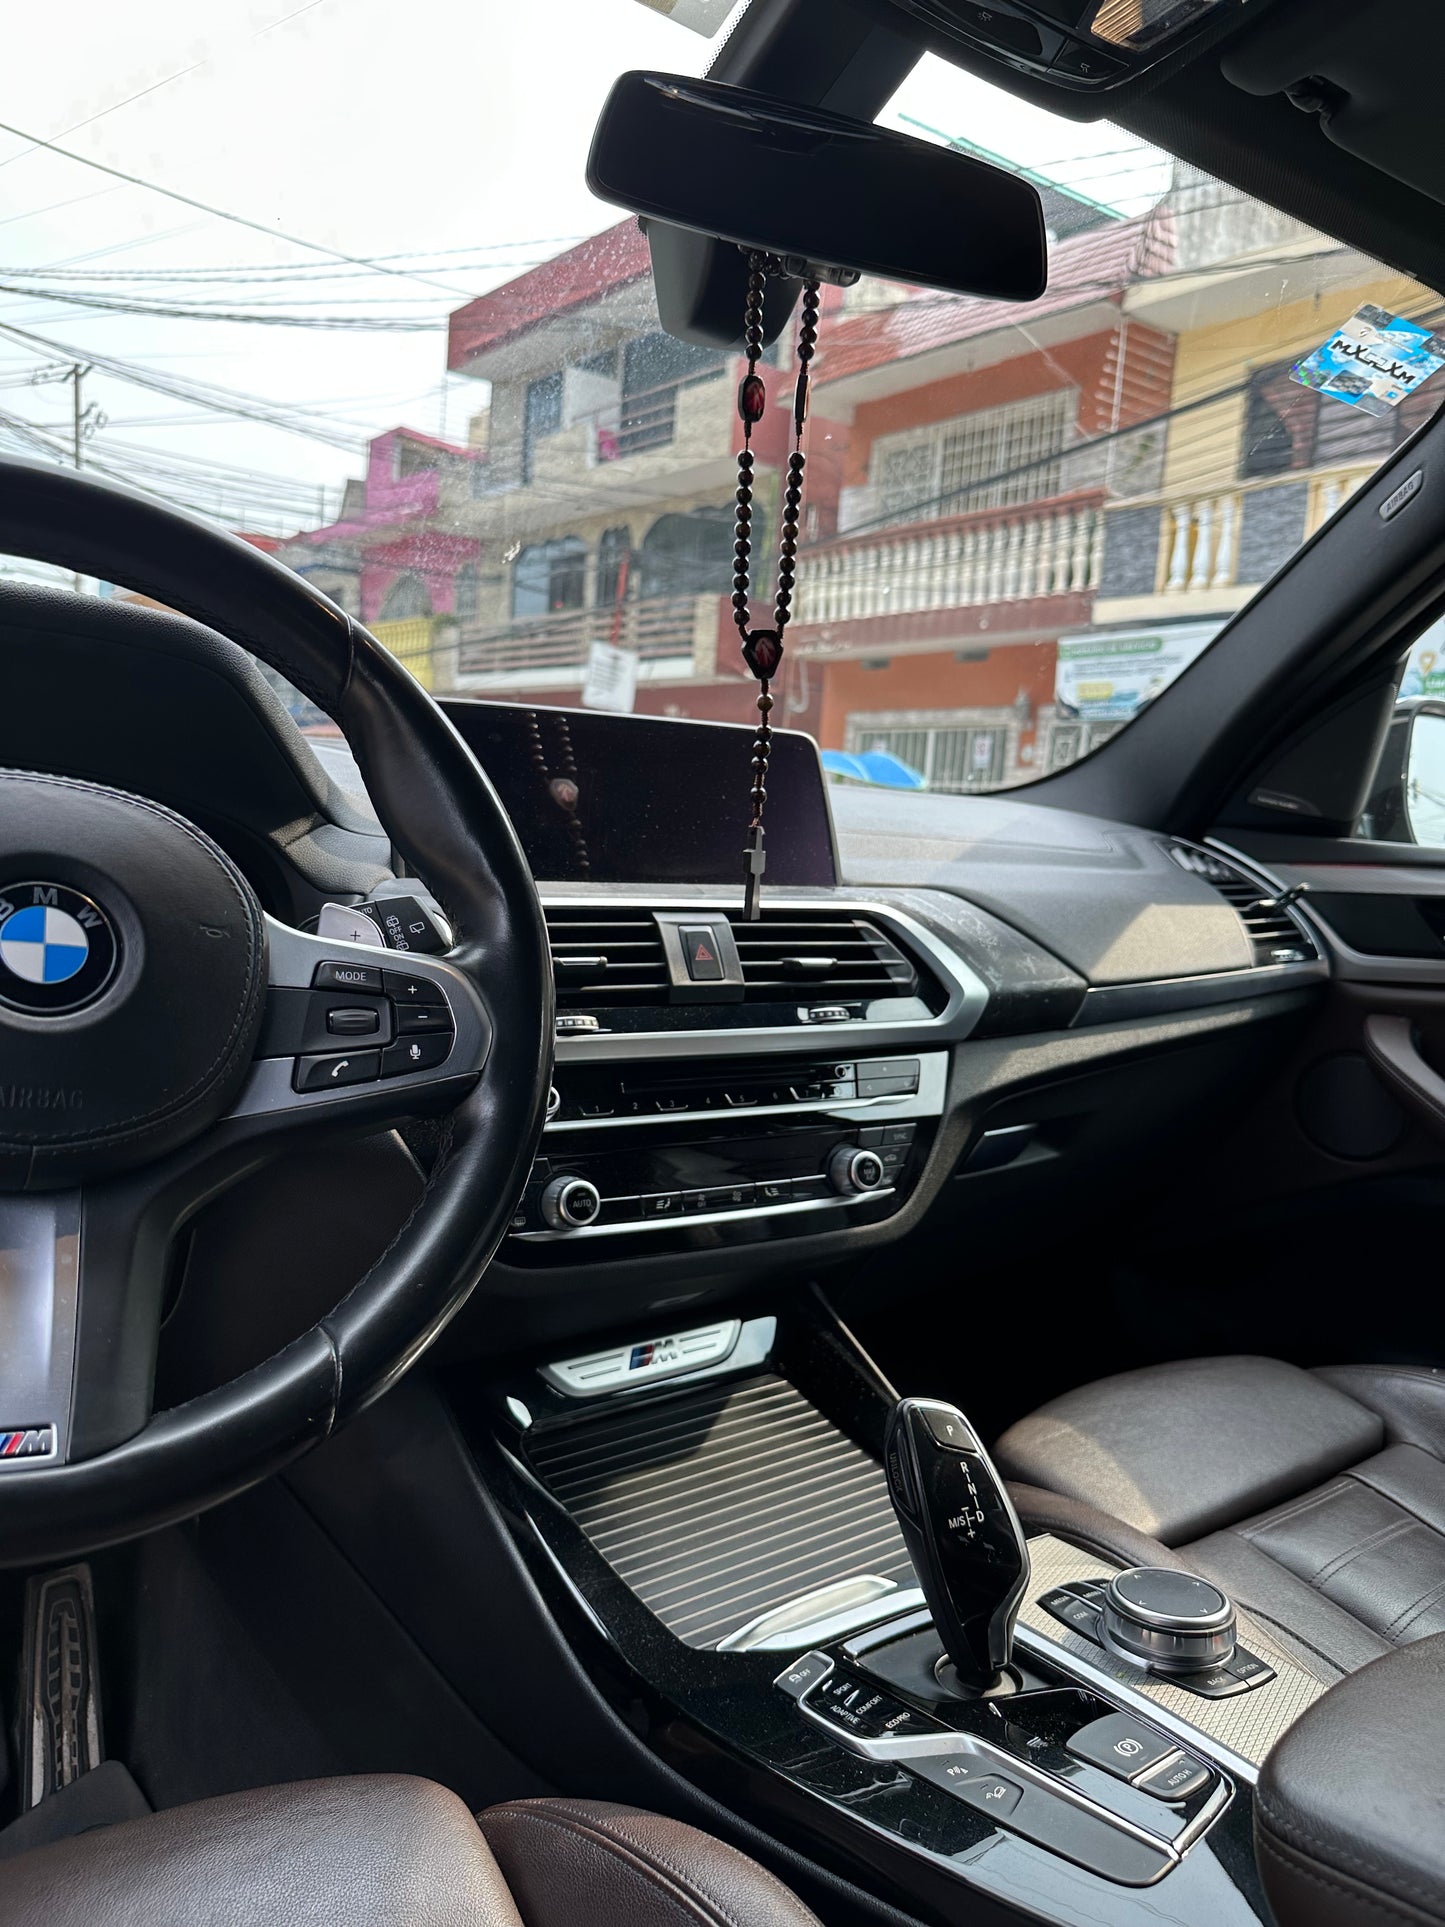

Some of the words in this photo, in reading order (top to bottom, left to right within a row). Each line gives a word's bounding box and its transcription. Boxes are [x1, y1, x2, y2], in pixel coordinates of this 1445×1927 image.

[1386, 481, 1414, 512] AIRBAG
[0, 886, 103, 929] BMW
[389, 925, 402, 936] OFF
[394, 933, 405, 942] ON
[335, 970, 367, 982] MODE
[632, 1102, 639, 1110] 2
[572, 1198, 592, 1209] AUTO
[946, 1425, 954, 1437] P
[889, 1452, 904, 1492] UNLOCK
[960, 1461, 970, 1474] R
[967, 1483, 978, 1495] N
[948, 1515, 966, 1529] M/S
[975, 1510, 985, 1523] D
[1050, 1595, 1071, 1606] MEDIA
[1073, 1611, 1089, 1620] COM
[800, 1668, 812, 1680] OFF
[1206, 1676, 1225, 1686] BACK
[833, 1682, 853, 1696] SPORT
[855, 1695, 883, 1715] COMFORT
[830, 1704, 861, 1724] ADAPTIVE
[1167, 1772, 1187, 1786] AUTO
[1182, 1768, 1193, 1776] H
